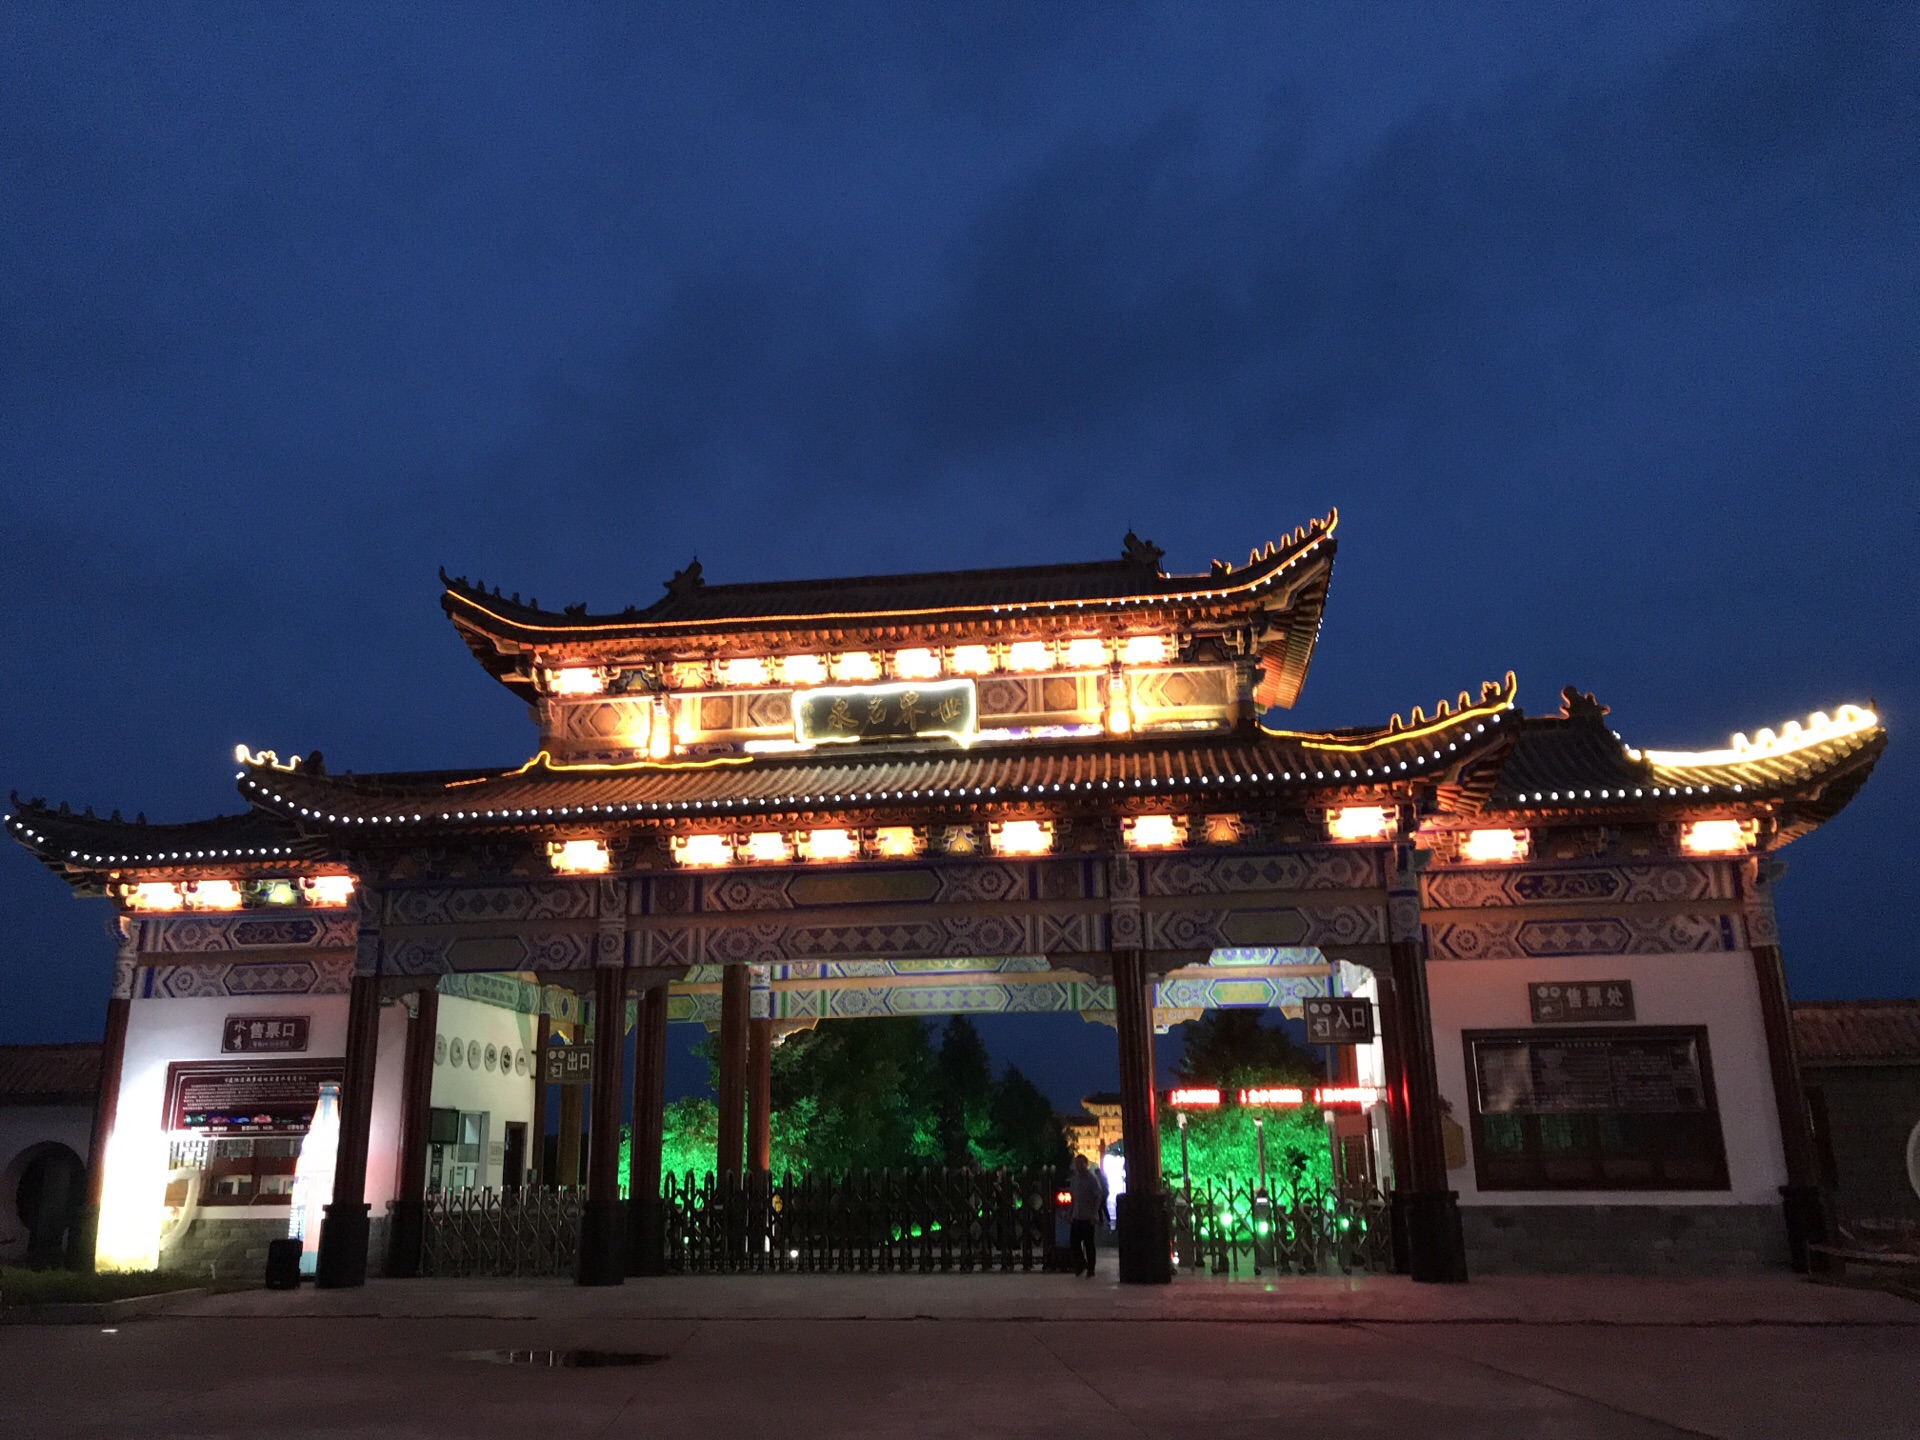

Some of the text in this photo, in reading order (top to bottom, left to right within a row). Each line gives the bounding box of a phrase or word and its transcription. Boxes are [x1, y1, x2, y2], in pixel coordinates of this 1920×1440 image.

[1566, 986, 1624, 1008] 售票处
[1335, 1005, 1366, 1029] 入口
[250, 1021, 295, 1039] 售票口
[567, 1051, 590, 1071] 出口
